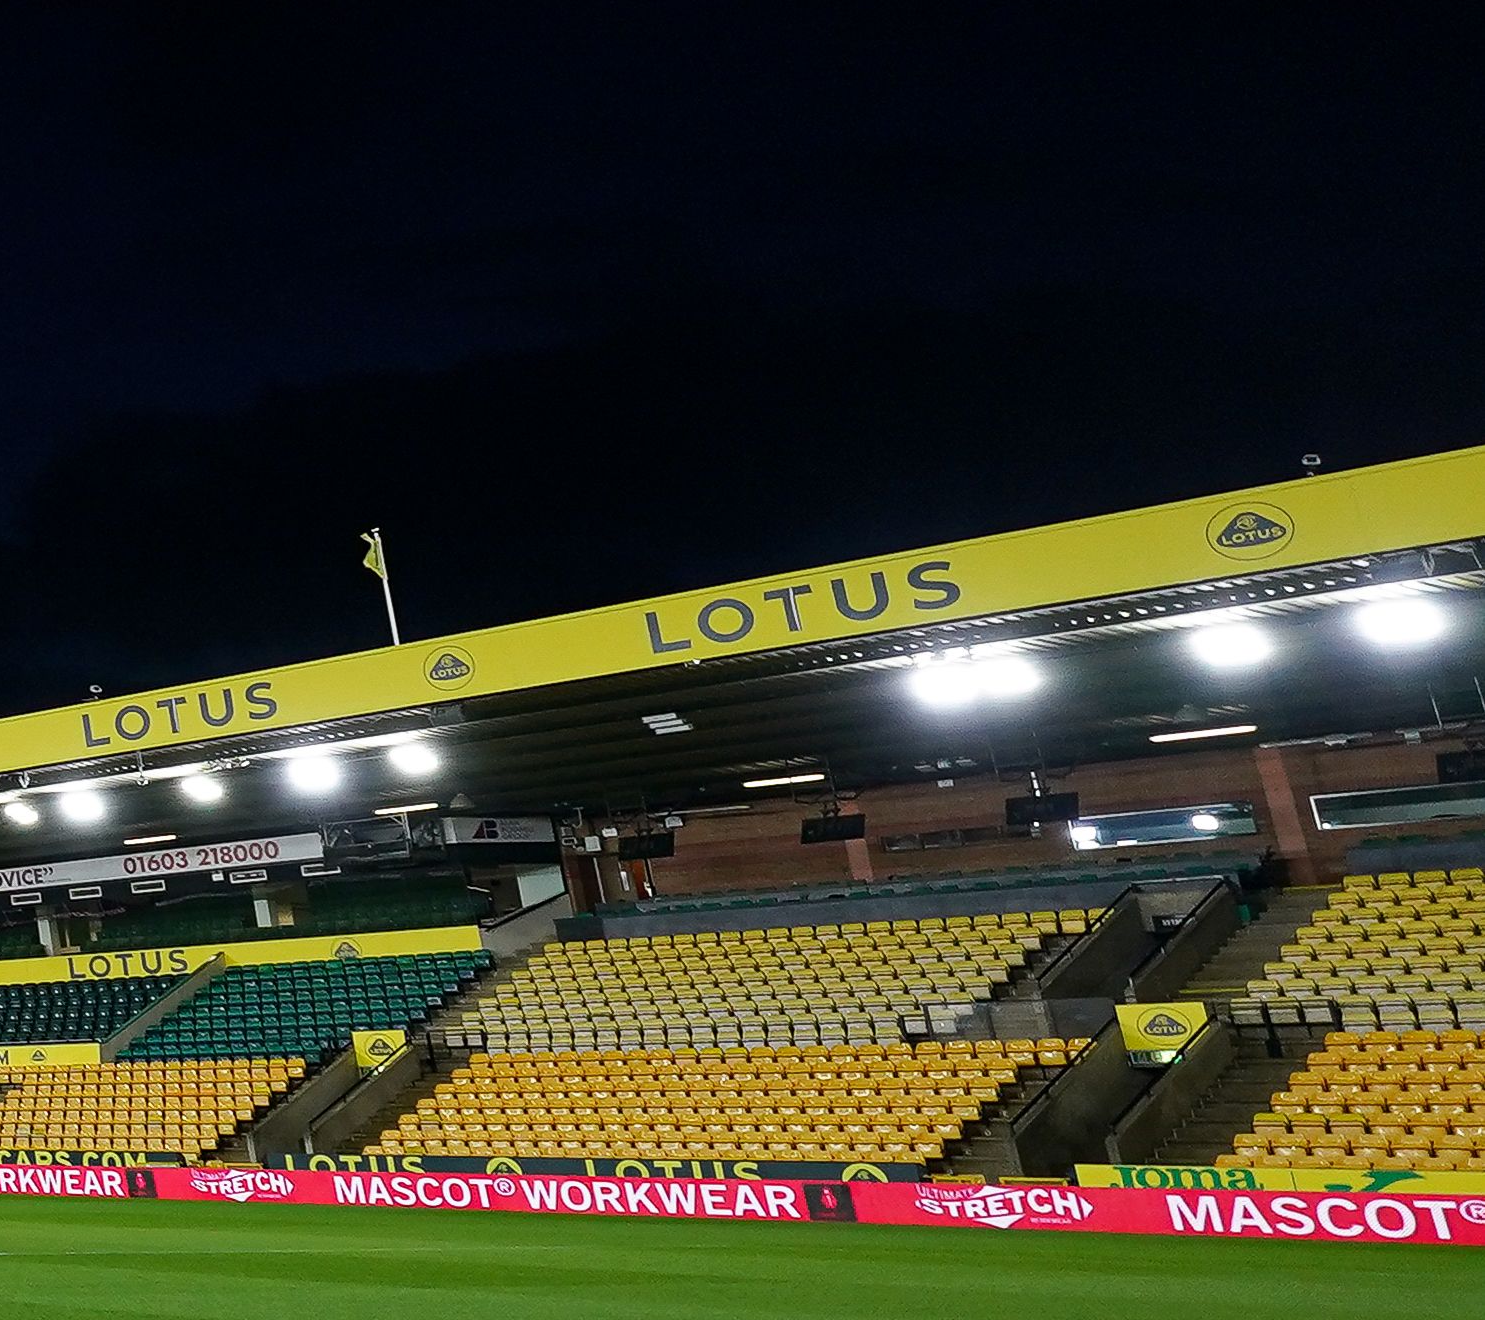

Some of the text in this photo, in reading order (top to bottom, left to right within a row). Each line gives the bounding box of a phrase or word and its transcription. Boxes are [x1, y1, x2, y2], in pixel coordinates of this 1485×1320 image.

[1221, 527, 1283, 545] LOTUS
[645, 561, 961, 655] LOTUS
[432, 666, 467, 679] LOTUS
[81, 681, 277, 748] LOTUS
[124, 851, 189, 875] 01603
[198, 840, 280, 866] 218000
[68, 949, 189, 980] LOTUS
[195, 1171, 287, 1195] STRETCH
[520, 1179, 802, 1219] WORKWEAR
[922, 1189, 1083, 1220] STRETCH
